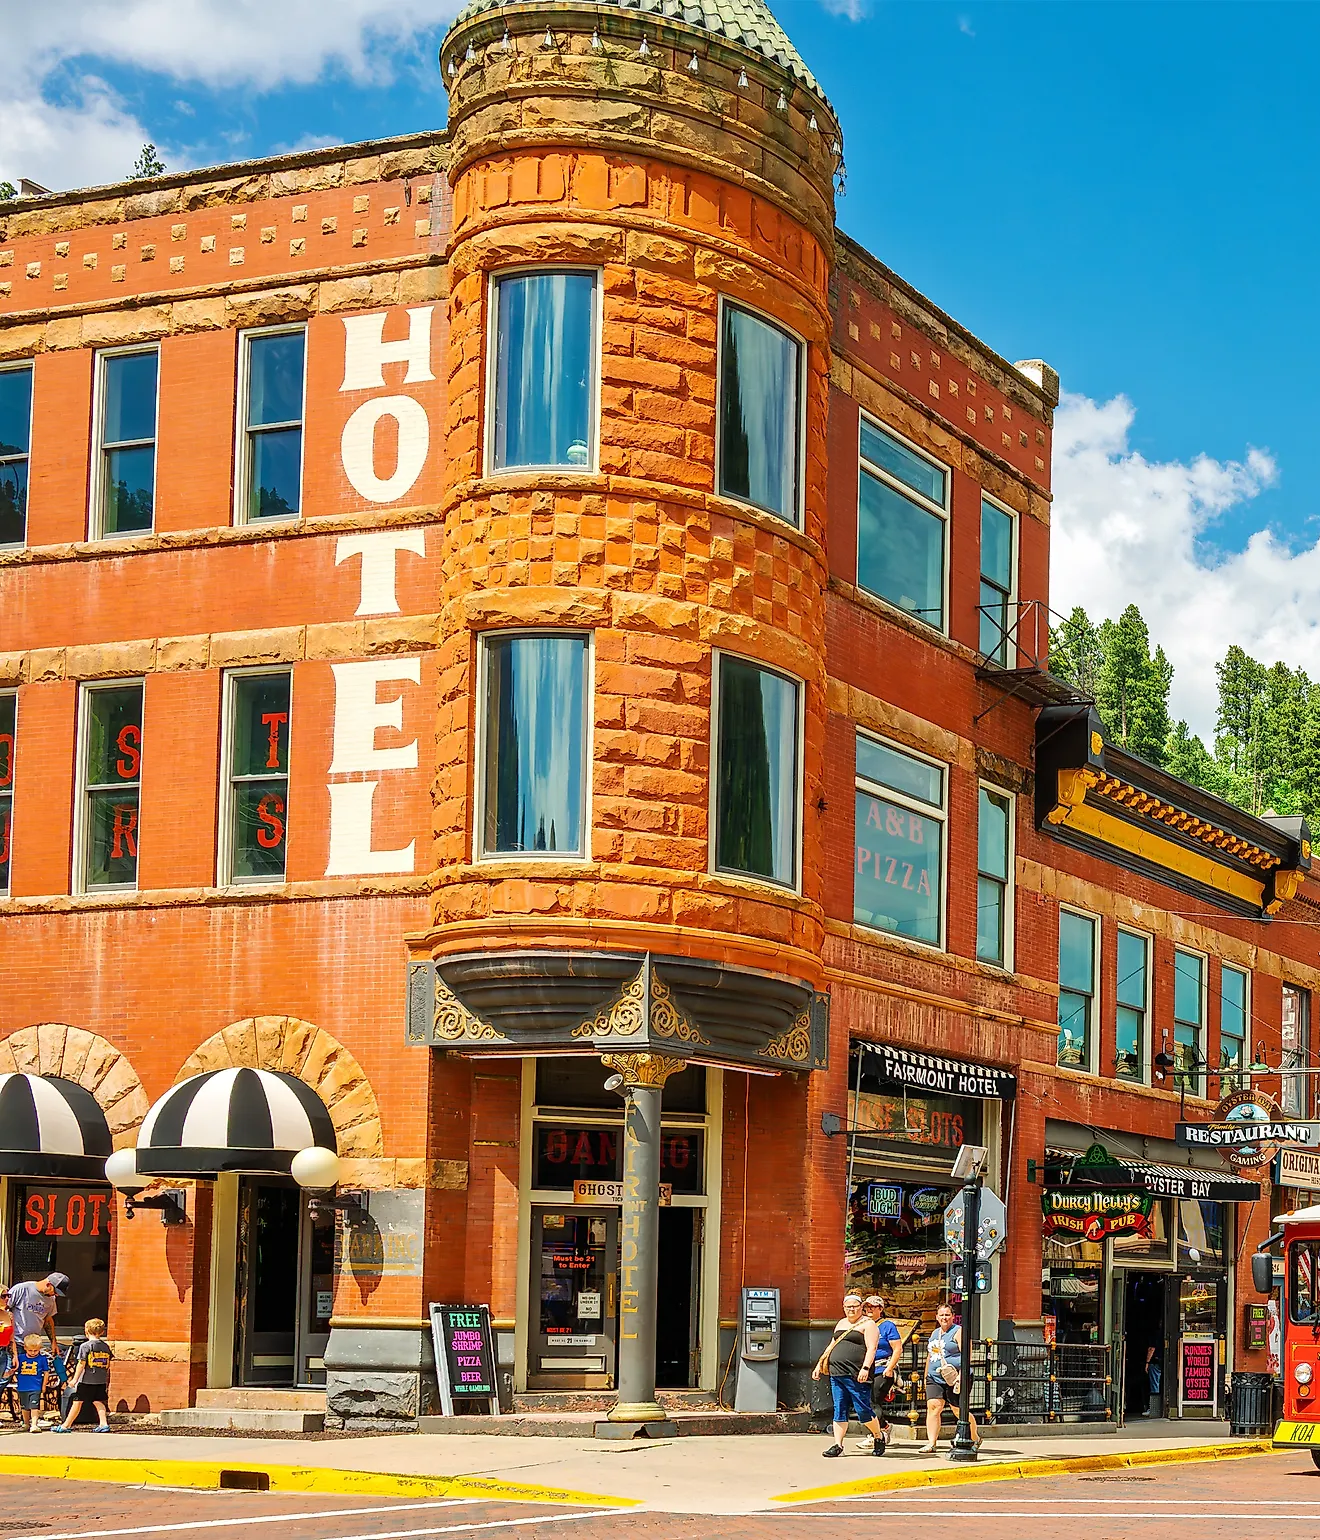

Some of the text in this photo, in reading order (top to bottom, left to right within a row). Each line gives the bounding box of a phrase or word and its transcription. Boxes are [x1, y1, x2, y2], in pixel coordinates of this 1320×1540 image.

[324, 305, 436, 877] HOTEL
[866, 802, 924, 845] A&B
[857, 846, 931, 897] PIZZA
[885, 1059, 1000, 1096] FAIRMONT HOTEL
[1221, 1093, 1257, 1113] OYSTER
[1185, 1123, 1311, 1144] RESTAURANT
[1229, 1153, 1267, 1166] GAMING
[578, 1184, 623, 1196] GHOST
[1144, 1175, 1211, 1197] OYSTER BAY
[874, 1188, 897, 1201] BUD
[870, 1201, 899, 1215] LIGHT
[1052, 1214, 1136, 1230] IRISH PUB
[449, 1313, 481, 1327] FREE
[453, 1331, 480, 1341] JUMBO
[452, 1341, 483, 1351] SHRIMP
[457, 1356, 482, 1366] PIZZA
[1187, 1356, 1210, 1366] WORLD
[461, 1372, 482, 1382] BEER
[1185, 1367, 1211, 1377] FAMOUS
[1186, 1379, 1210, 1388] OYSTER
[1290, 1424, 1316, 1442] KOA
